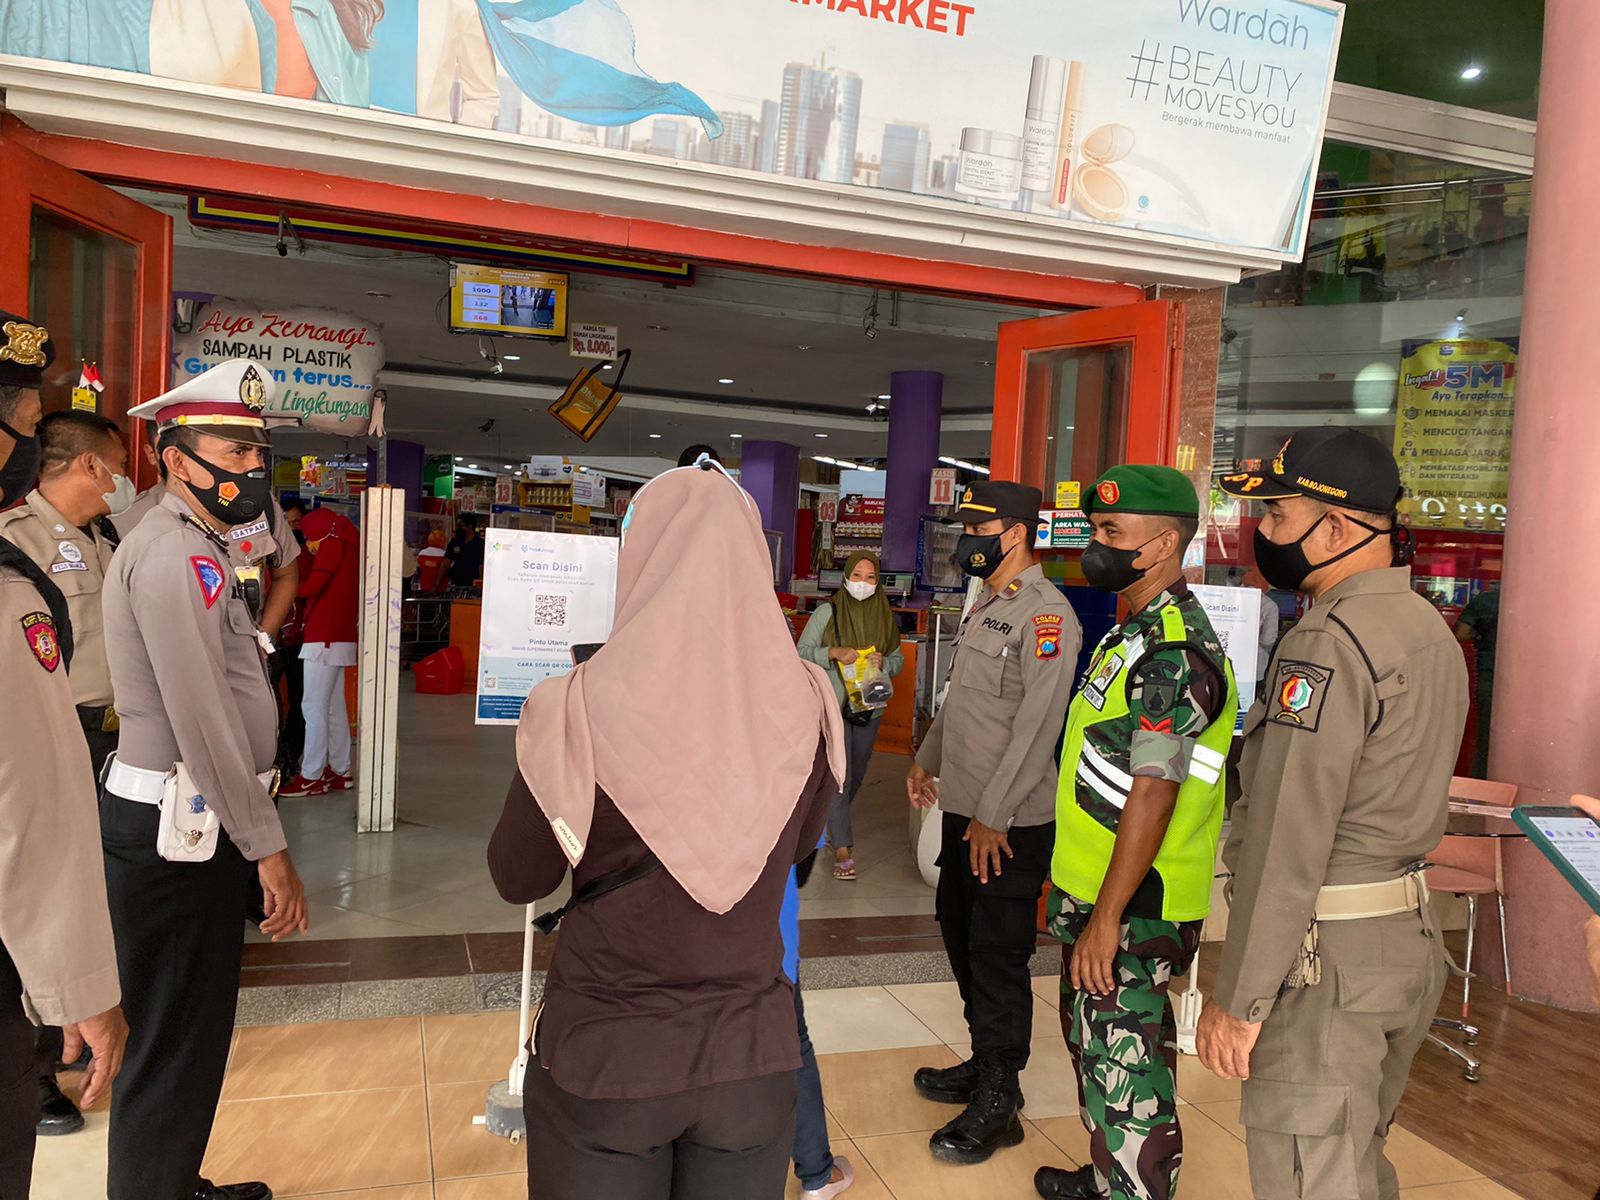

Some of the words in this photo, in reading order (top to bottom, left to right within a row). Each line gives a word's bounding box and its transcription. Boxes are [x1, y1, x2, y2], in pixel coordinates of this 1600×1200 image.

[1164, 84, 1296, 129] MOVESYOU
[1162, 110, 1204, 128] Bergerak
[1205, 120, 1252, 137] membawa
[1254, 129, 1291, 145] manfaat
[471, 286, 492, 294] 1000
[198, 310, 255, 338] Ayo
[202, 339, 272, 361] SAMPAH
[283, 347, 352, 369] PLASTIK
[1444, 364, 1504, 389] 5M
[1432, 390, 1450, 403] Ayo
[281, 389, 370, 422] Lingkungan
[1424, 408, 1472, 417] MEMAKAI
[1474, 409, 1514, 418] MASKER
[1423, 428, 1468, 436] MENCUCI
[1470, 428, 1513, 437] TANGAN
[1421, 448, 1469, 457] MENJAGA
[1471, 449, 1506, 458] JARAK
[1420, 464, 1465, 472] MEMBATASI
[1418, 472, 1436, 480] DAN
[496, 484, 511, 500] 13
[934, 479, 951, 503] 11
[217, 497, 230, 507] TNI
[820, 501, 836, 521] 03
[233, 521, 266, 538] SATPAM
[1073, 521, 1092, 529] WAJ
[522, 560, 549, 571] Scan
[552, 561, 583, 573] Disini
[1221, 604, 1240, 614] Disini
[982, 617, 1014, 636] POLRI
[529, 638, 547, 646] Pintu
[547, 639, 569, 647] Utama
